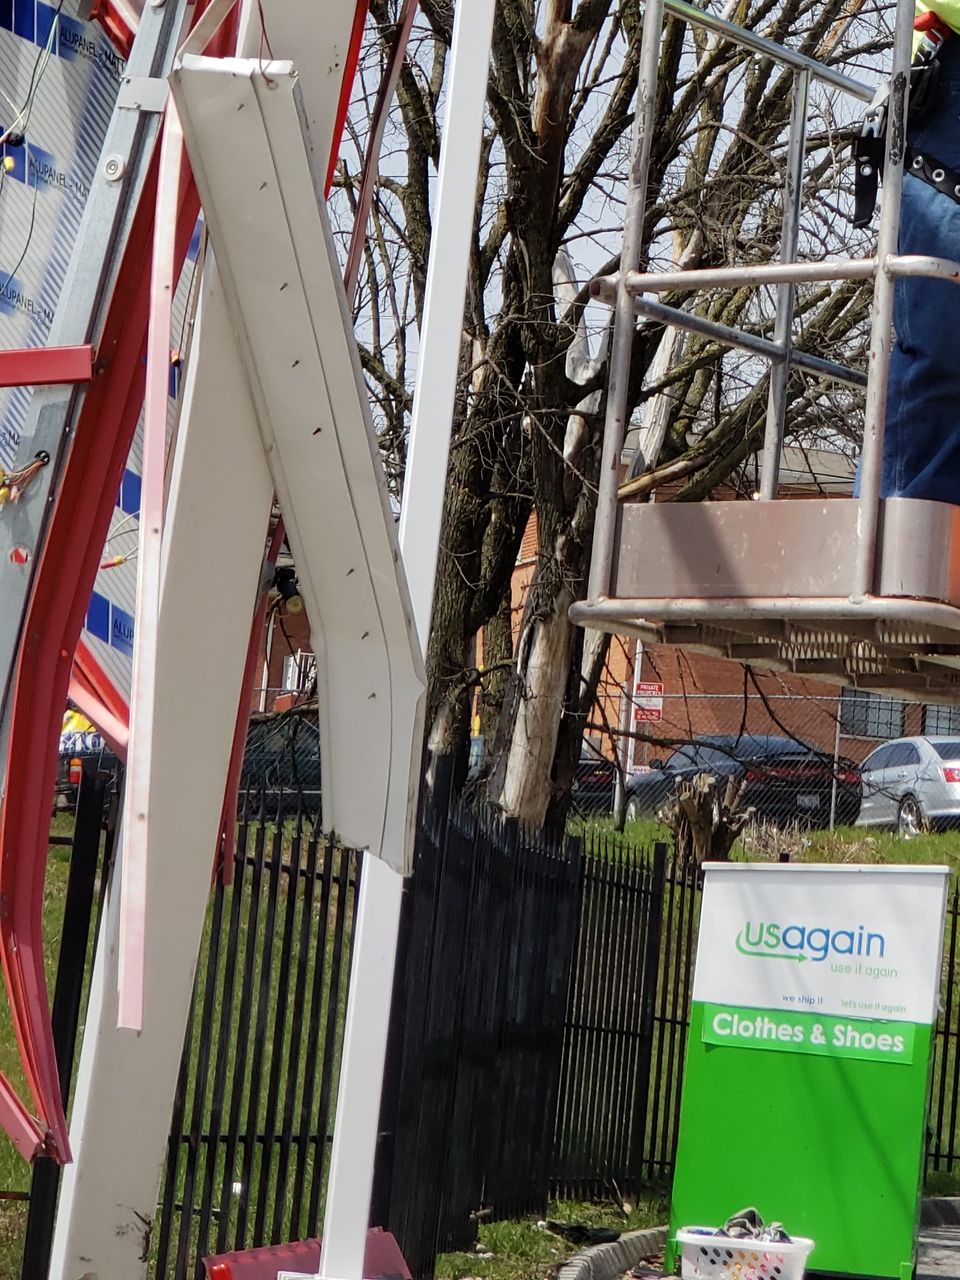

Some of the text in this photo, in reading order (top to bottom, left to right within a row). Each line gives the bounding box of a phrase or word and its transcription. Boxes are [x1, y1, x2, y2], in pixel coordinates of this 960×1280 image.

[60, 26, 97, 59] ALUPANEL
[830, 963, 898, 979] use it again
[782, 994, 823, 1005] we ship it
[858, 1001, 872, 1010] use
[881, 1004, 907, 1014] again
[712, 1012, 905, 1053] Clothes & Shoes
